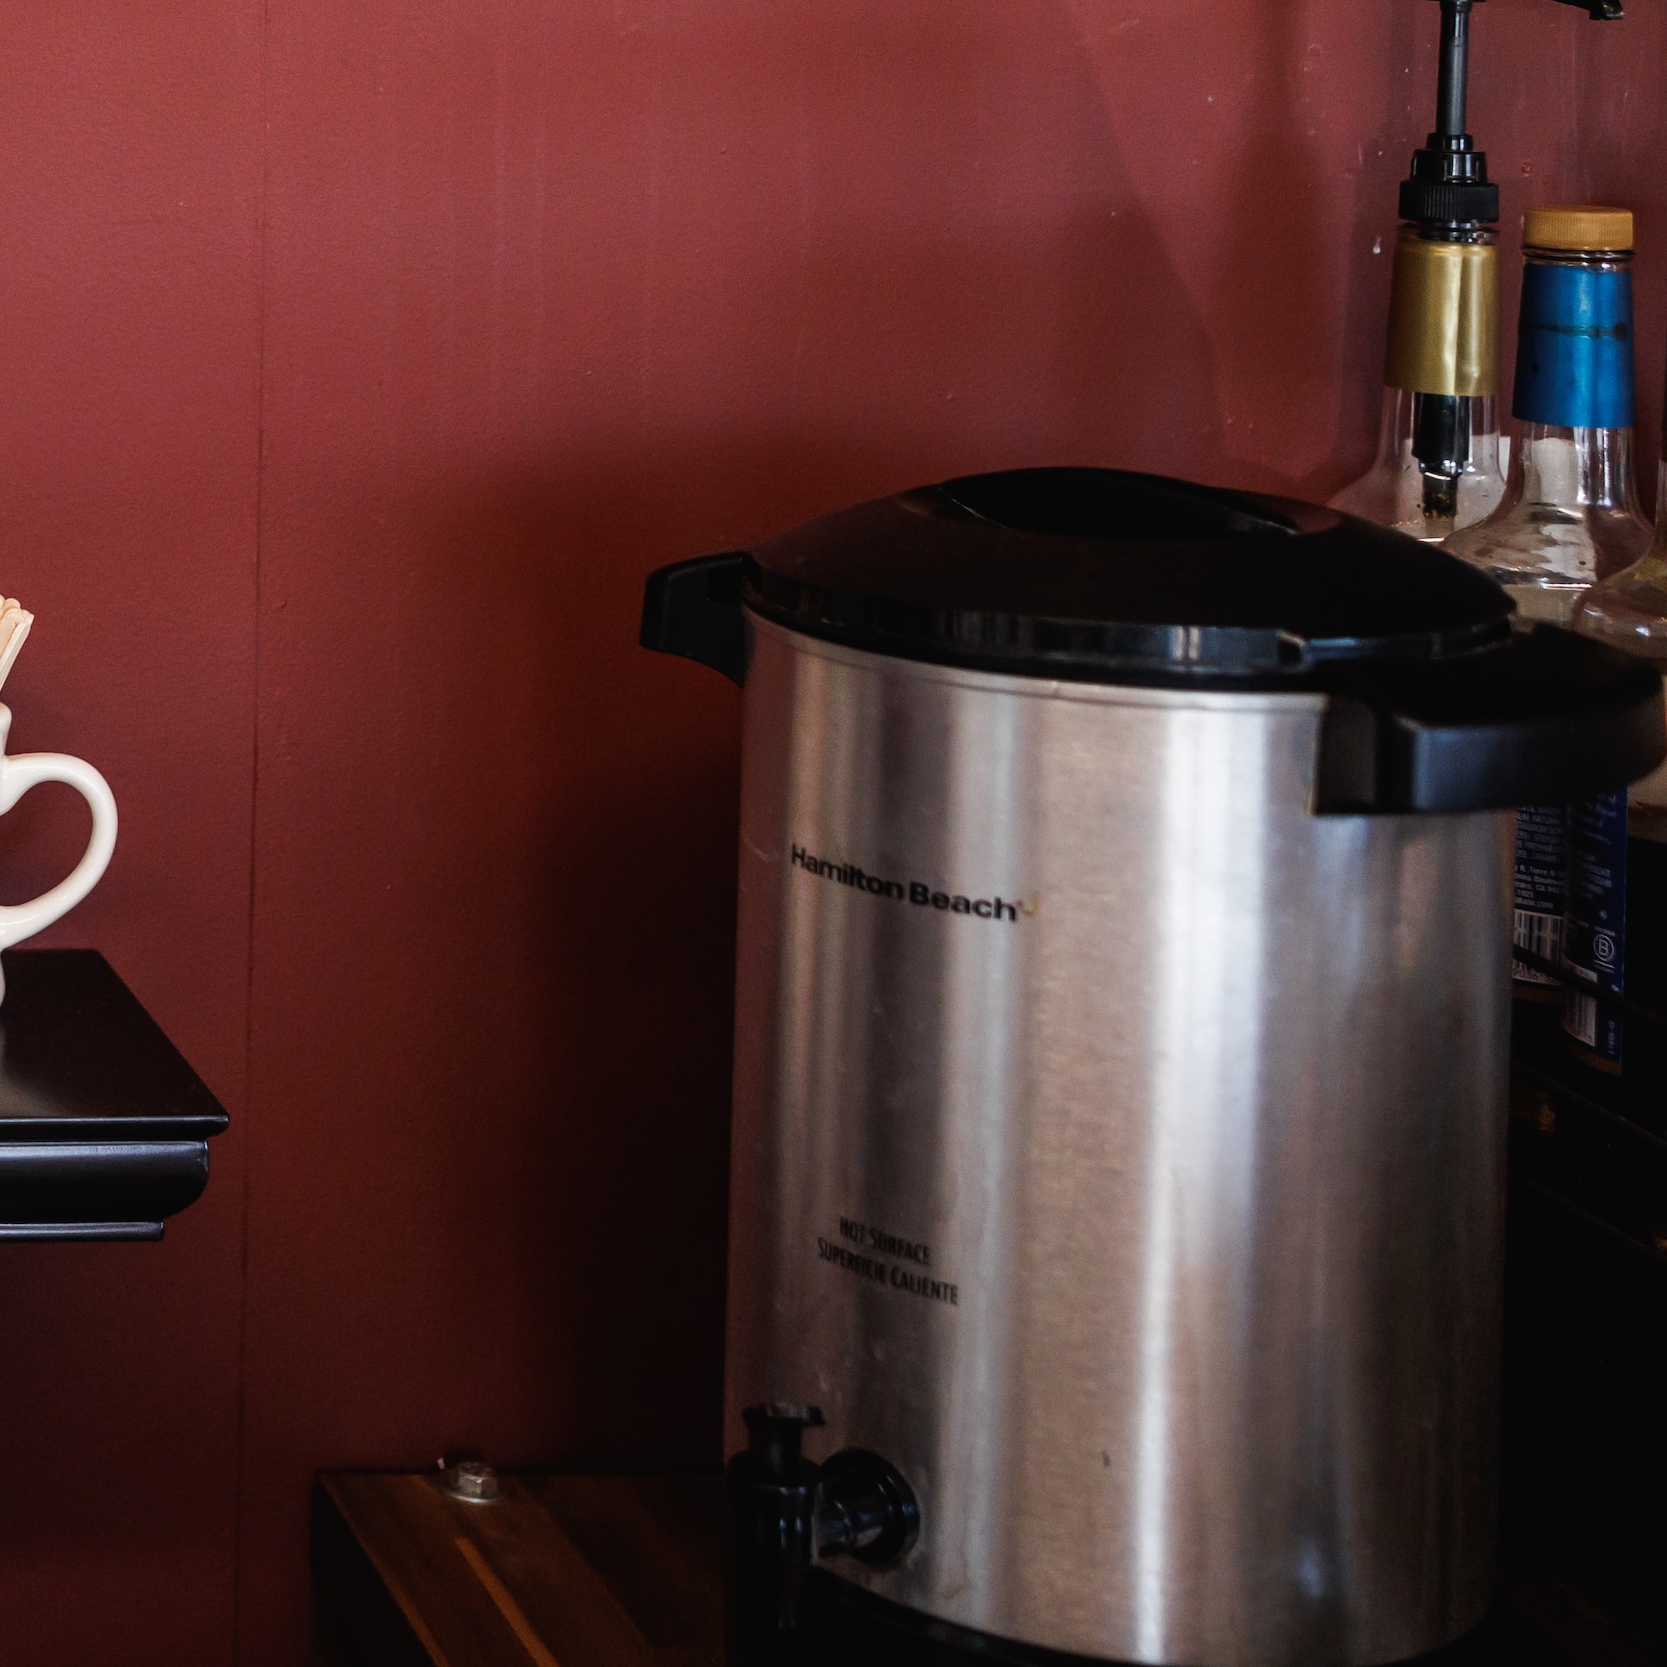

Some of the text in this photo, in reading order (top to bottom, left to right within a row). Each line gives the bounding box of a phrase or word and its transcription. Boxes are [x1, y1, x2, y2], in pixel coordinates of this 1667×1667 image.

[790, 844, 1017, 922] Hamilton Beach
[840, 1217, 930, 1267] HOT SURFACE
[891, 1265, 959, 1306] CALIENTE
